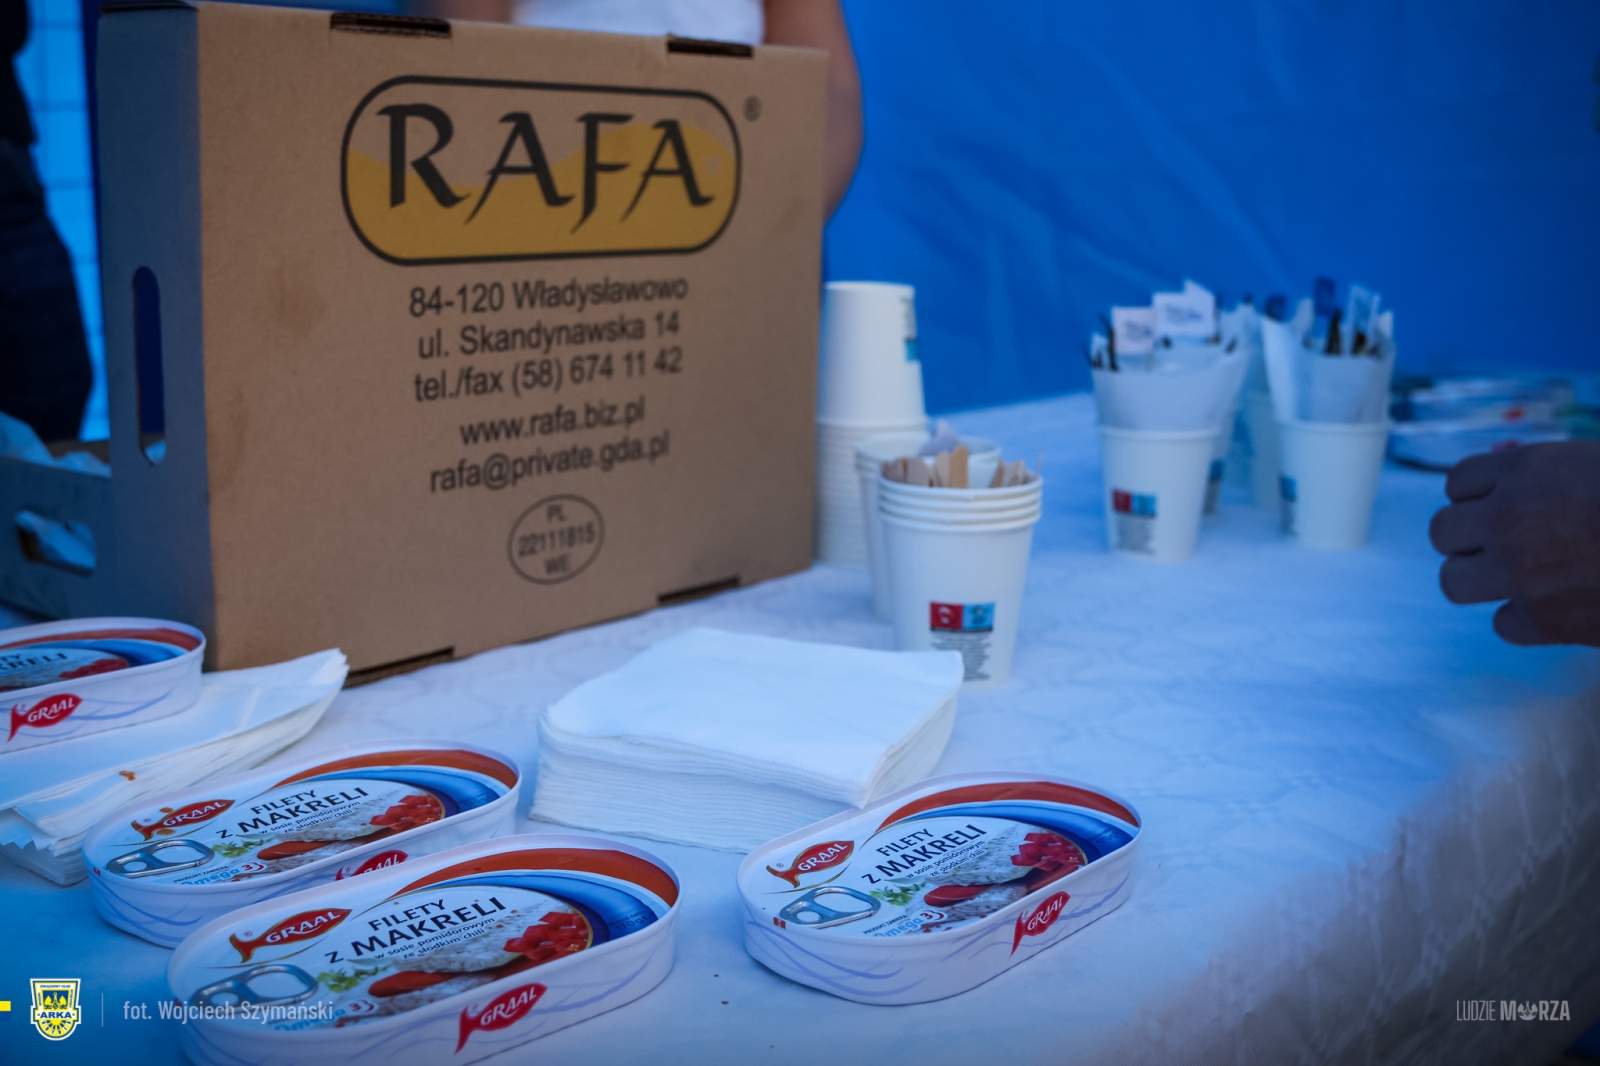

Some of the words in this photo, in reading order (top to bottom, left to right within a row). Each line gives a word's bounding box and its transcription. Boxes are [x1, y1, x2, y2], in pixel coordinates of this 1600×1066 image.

[376, 103, 715, 235] RAFA
[410, 282, 504, 317] 84-120
[512, 276, 689, 313] Władysławowo
[418, 328, 449, 359] ul.
[460, 314, 645, 355] Skandynawska
[655, 310, 680, 337] 14
[414, 366, 504, 401] tel./fax
[511, 358, 563, 397] (58)
[569, 354, 613, 384] 674
[624, 351, 646, 377] 11
[654, 346, 683, 375] 42
[460, 395, 646, 446] www.rafa.biz.pl
[430, 428, 671, 493] rafa@private.gda.pl
[27, 697, 75, 723] GRAAL
[163, 801, 226, 826] GRAAL
[237, 787, 369, 833] MAKRELI
[250, 789, 318, 814] FILETY
[295, 801, 361, 825] pomidorowym
[797, 843, 848, 871] GRAAL
[875, 828, 934, 857] FILETY
[875, 824, 987, 877] MAKRELI
[265, 911, 341, 943] GRAAL
[351, 896, 507, 957] MAKRELI
[367, 899, 446, 931] FILETY
[1027, 895, 1063, 931] GRAAL
[388, 943, 415, 956] sosie
[417, 917, 496, 947] pomidorowym
[463, 928, 486, 940] chili
[481, 986, 537, 1026] GRAAL
